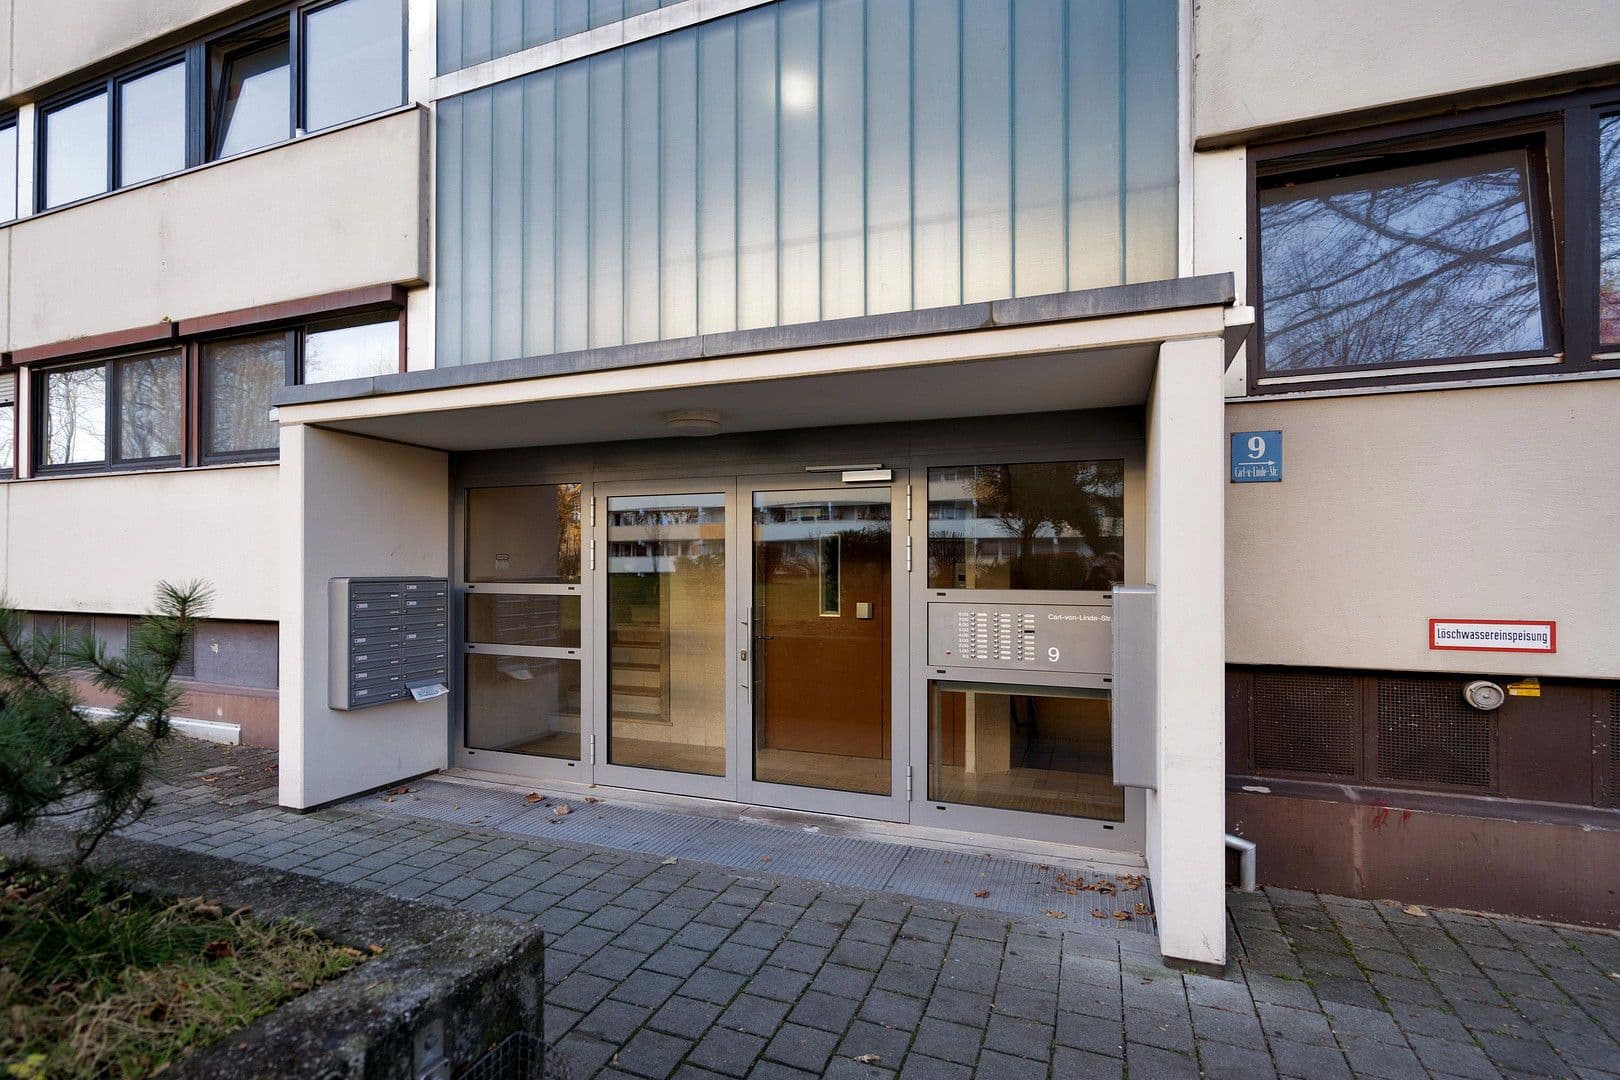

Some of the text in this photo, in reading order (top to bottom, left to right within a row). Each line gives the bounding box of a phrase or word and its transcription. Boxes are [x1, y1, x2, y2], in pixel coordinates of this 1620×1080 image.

[1247, 436, 1266, 459] 9
[1436, 627, 1549, 645] Löschwassereinspeisung
[1047, 646, 1060, 663] 9
